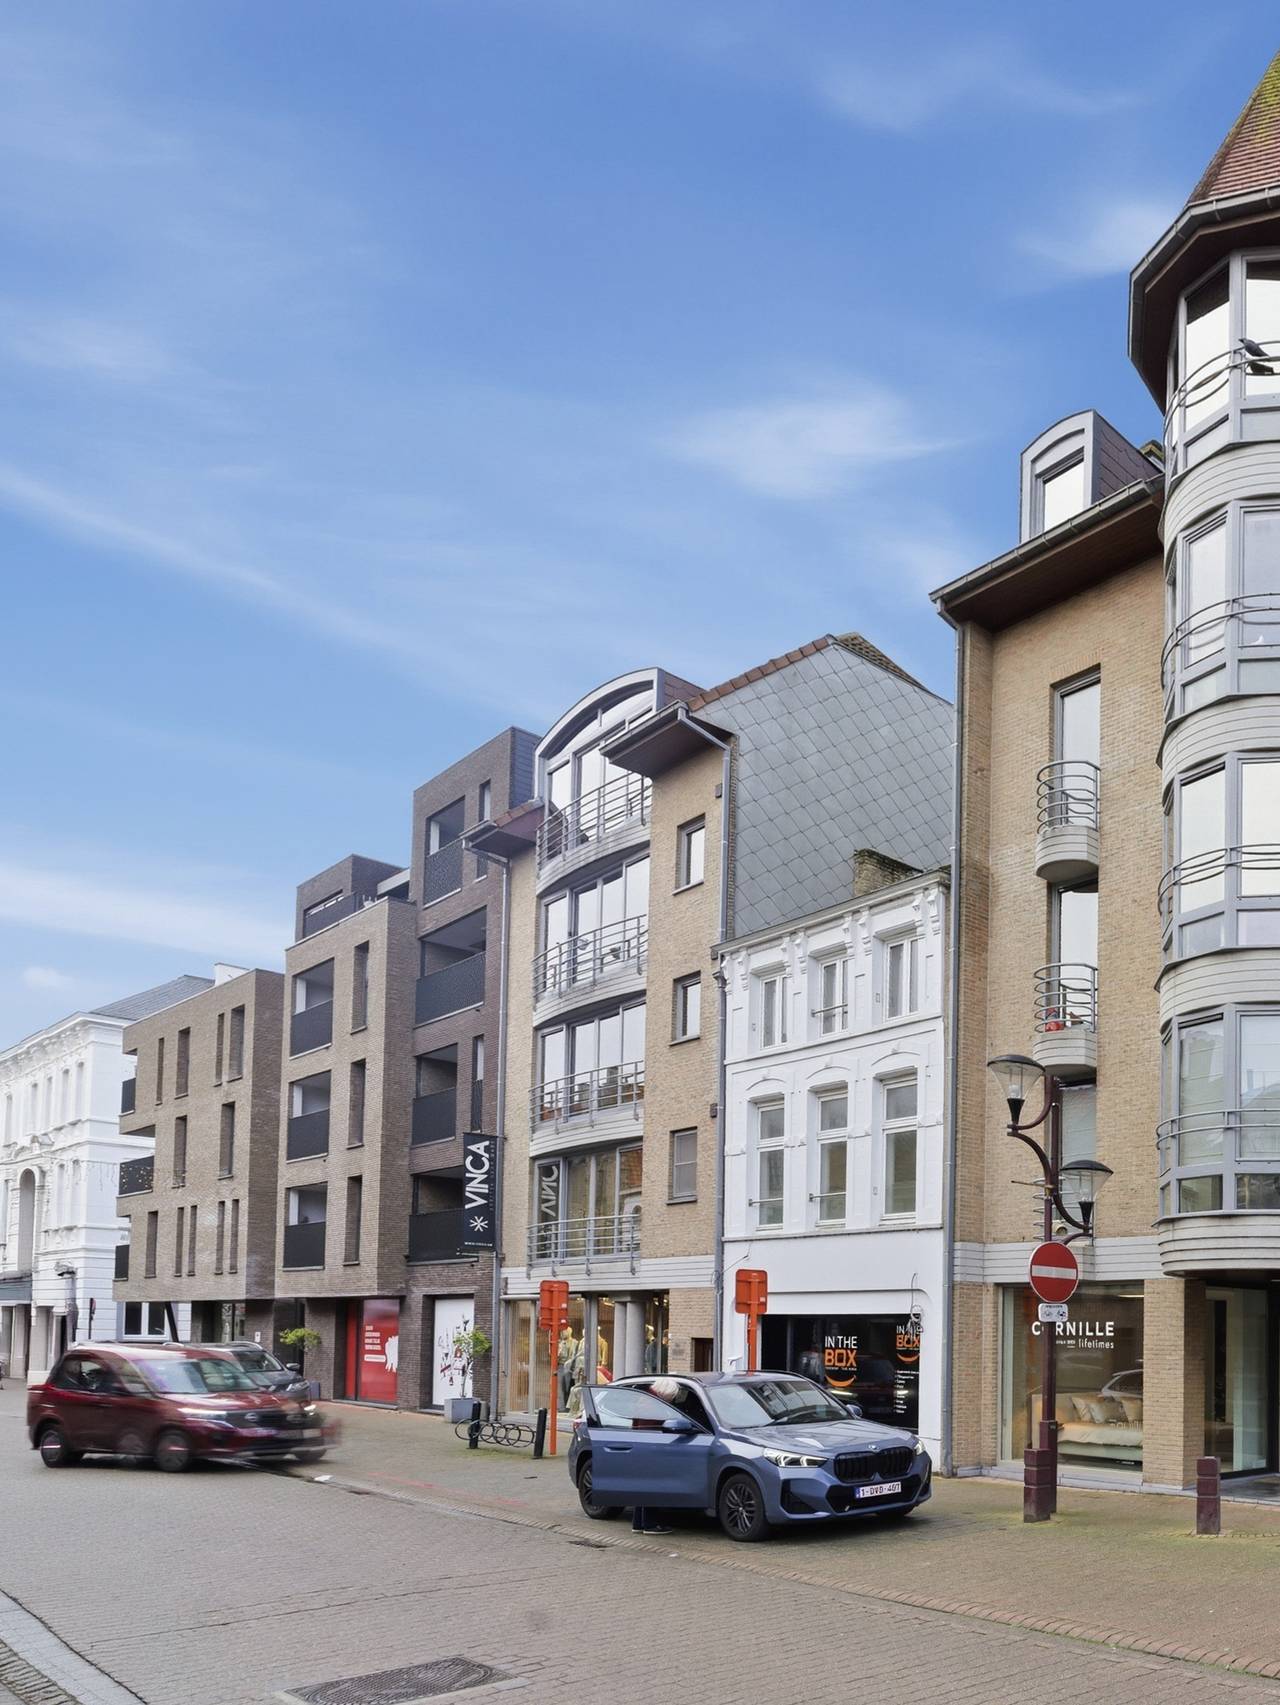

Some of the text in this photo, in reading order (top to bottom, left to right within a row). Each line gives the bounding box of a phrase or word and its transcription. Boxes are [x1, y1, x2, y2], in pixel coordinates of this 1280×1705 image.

[465, 1140, 490, 1209] VINCA
[1032, 1321, 1114, 1336] CRNILLE
[824, 1336, 858, 1349] IN THE
[1079, 1338, 1114, 1349] lifetimes
[824, 1349, 857, 1367] BOX
